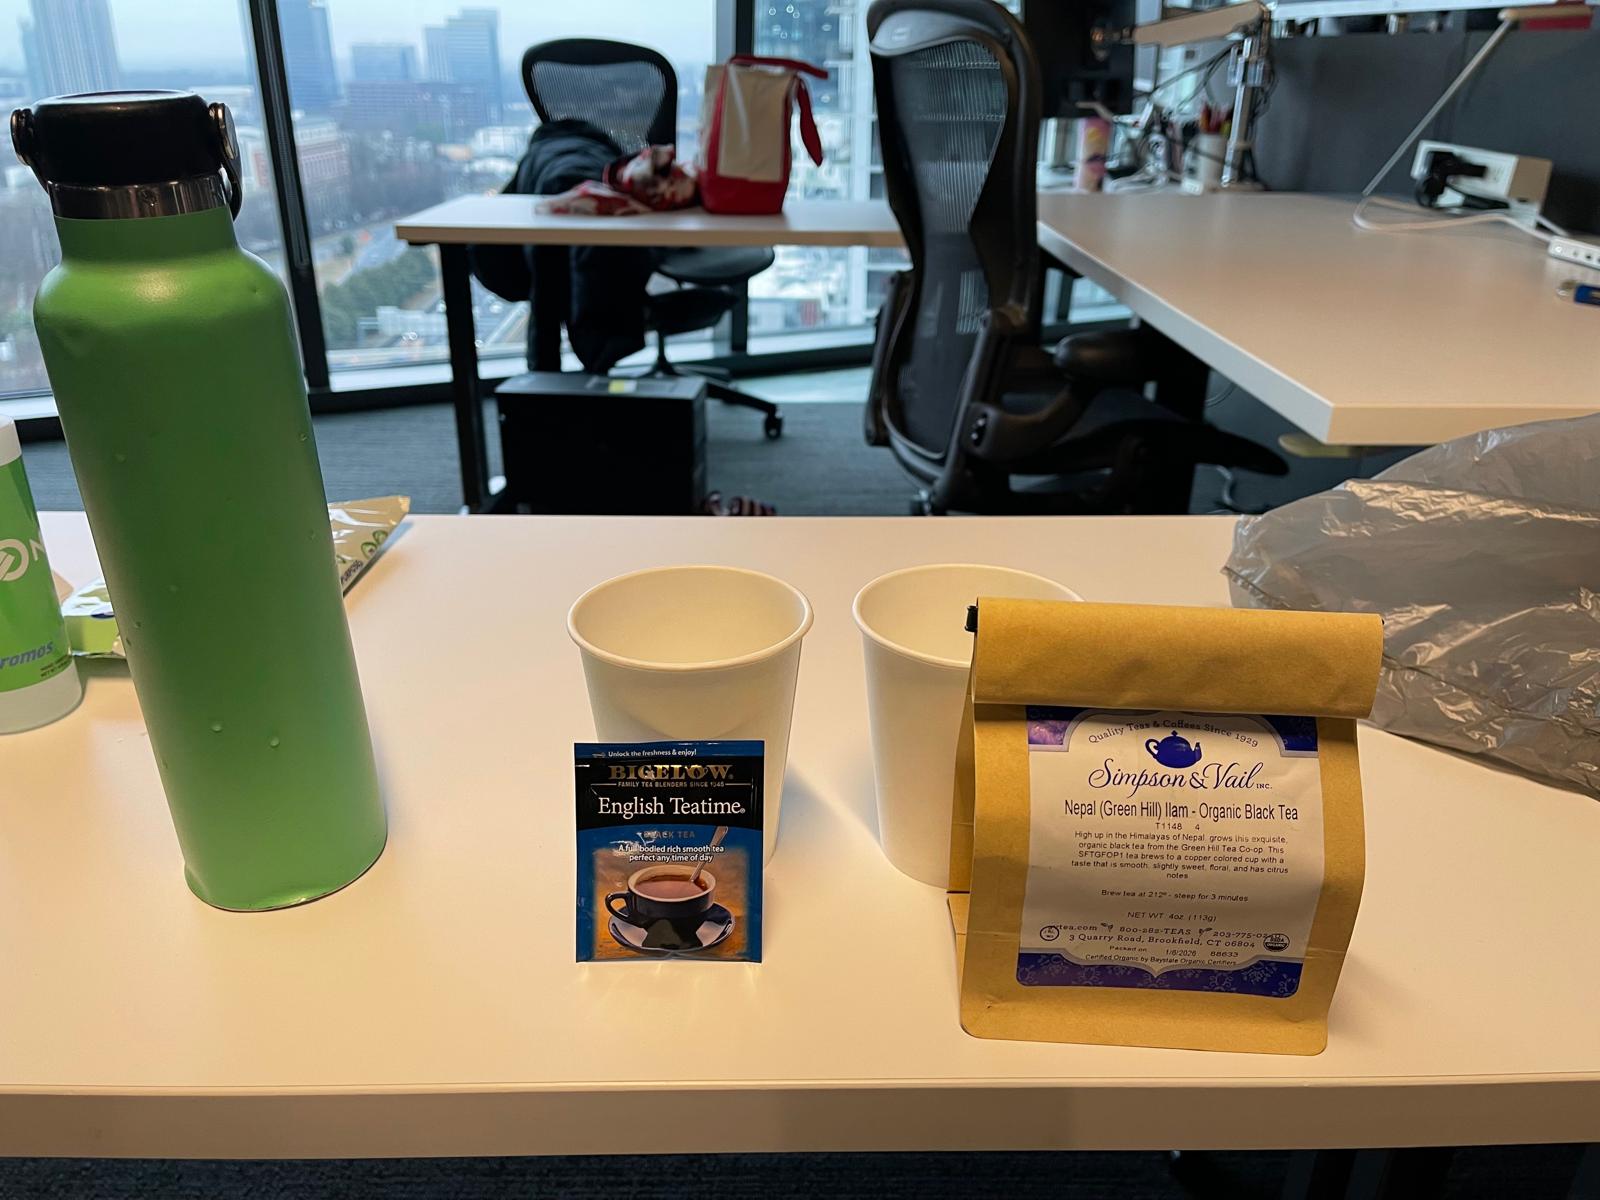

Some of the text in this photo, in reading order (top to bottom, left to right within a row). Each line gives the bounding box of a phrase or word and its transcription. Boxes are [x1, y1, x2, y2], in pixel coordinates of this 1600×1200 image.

[1088, 719, 1258, 748] Quality Teas & Coffees Since 1929
[677, 749, 697, 757] enjoy!
[608, 764, 733, 780] BIGELOW
[1088, 758, 1187, 799] Simpson
[1189, 771, 1208, 790] &
[1203, 762, 1264, 790] Vail
[598, 796, 665, 819] English
[1065, 800, 1096, 819] Nepal
[1100, 800, 1137, 819] (Green
[1140, 801, 1162, 821] Hill)
[1199, 802, 1241, 822] Organic
[1245, 804, 1275, 820] Black
[1278, 805, 1298, 820] Tea
[1155, 822, 1182, 830] T1148
[677, 831, 695, 839] TEA
[1075, 831, 1092, 840] High
[1129, 832, 1170, 841] Himalayas
[1182, 834, 1205, 842] Nepal
[1209, 835, 1233, 843] grows
[1235, 834, 1249, 842] this
[639, 845, 666, 853] bodied
[666, 845, 681, 853] rich
[682, 845, 711, 853] smooth
[1078, 842, 1107, 850] organic
[1109, 842, 1130, 850] black
[1166, 843, 1179, 851] the
[1182, 843, 1206, 852] Green
[1207, 844, 1220, 852] Hill
[1222, 845, 1237, 853] Tea
[1268, 846, 1285, 854] This
[629, 854, 656, 862] perfect
[699, 854, 714, 862] day
[1078, 850, 1123, 859] SFTGFOP1
[1213, 855, 1243, 863] colored
[1093, 860, 1108, 868] that
[1153, 862, 1179, 871] slightly
[1233, 865, 1248, 873] and
[1267, 866, 1289, 874] citrus
[1218, 894, 1249, 902] minutes
[1127, 911, 1146, 919] NET
[1188, 914, 1217, 922] (113g)
[1119, 926, 1191, 935] 800-282-TEAS
[1078, 933, 1114, 941] Quarry
[1117, 934, 1144, 943] Road,
[1148, 936, 1202, 946] Brookfield,
[1206, 939, 1221, 947] CT
[1224, 940, 1255, 948] 06804
[1113, 954, 1139, 962] Organic
[1140, 955, 1149, 963] by
[1150, 956, 1179, 964] Baystate
